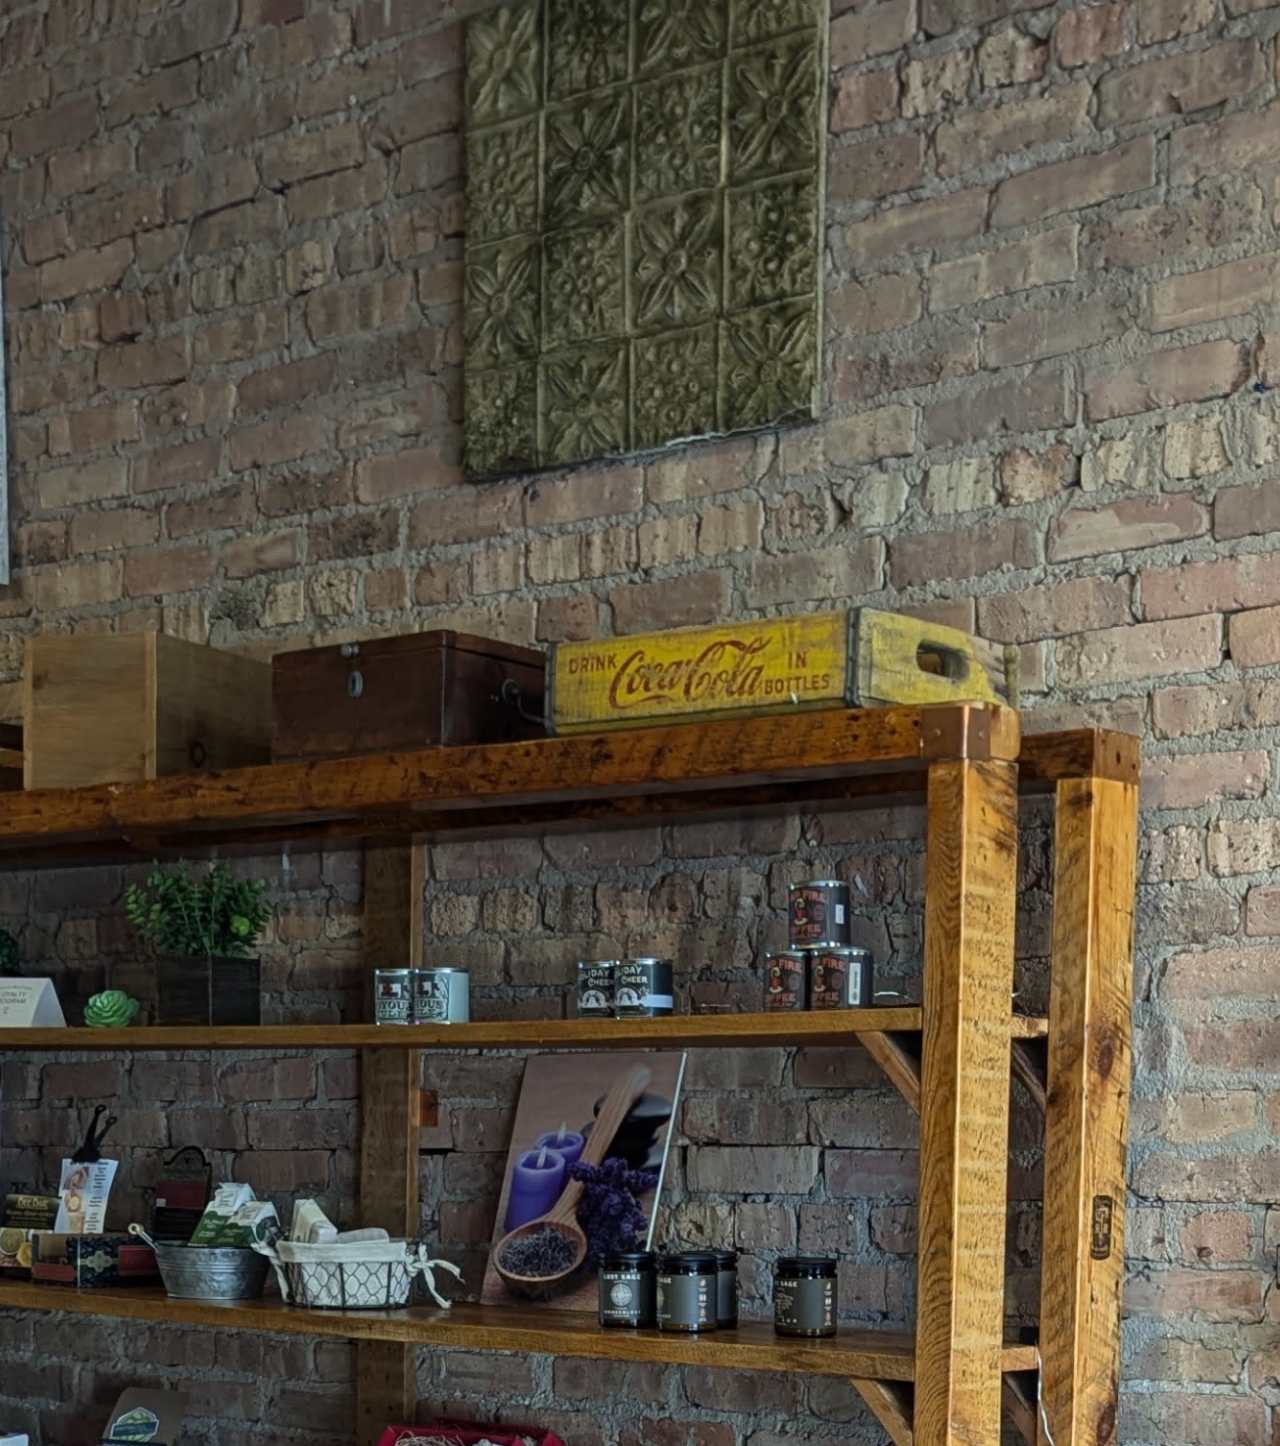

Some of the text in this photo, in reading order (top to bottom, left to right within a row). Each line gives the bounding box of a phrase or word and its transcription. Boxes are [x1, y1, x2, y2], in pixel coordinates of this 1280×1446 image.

[569, 653, 618, 675] DRINK
[787, 651, 807, 669] IN
[763, 673, 831, 695] BOTTLES
